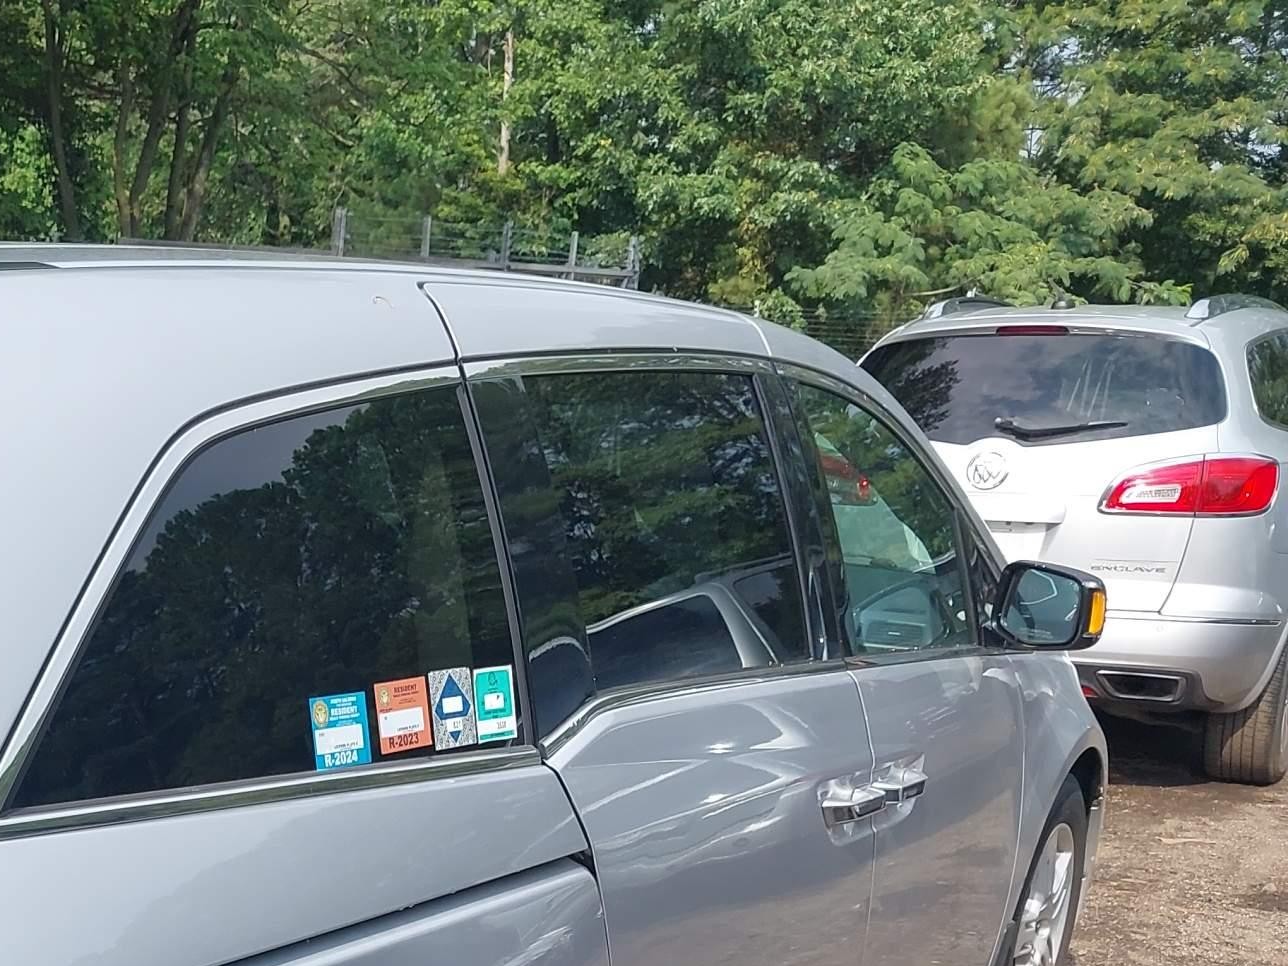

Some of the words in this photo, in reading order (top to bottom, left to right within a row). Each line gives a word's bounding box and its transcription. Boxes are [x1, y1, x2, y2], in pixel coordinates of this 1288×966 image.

[1090, 565, 1167, 574] ENCLAVE
[388, 732, 420, 749] R-2023
[324, 750, 358, 768] R-2024
